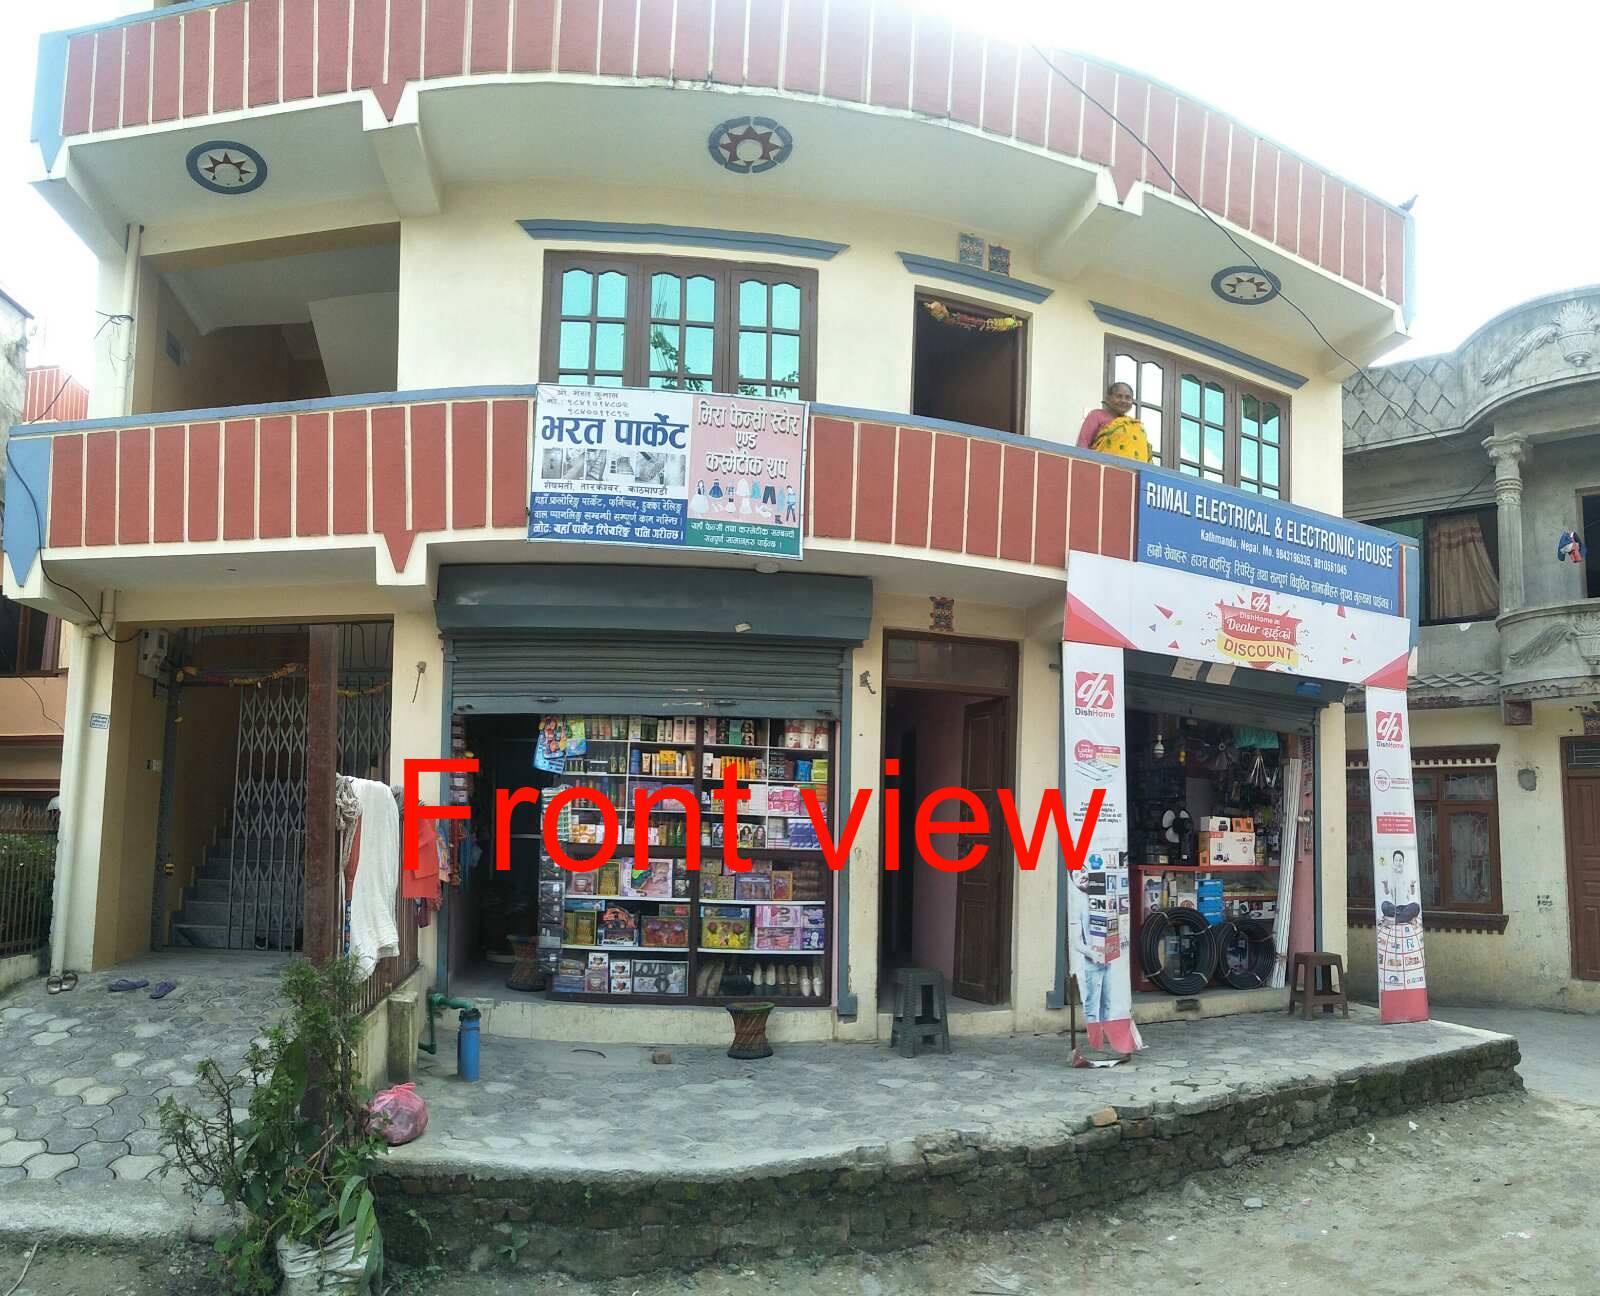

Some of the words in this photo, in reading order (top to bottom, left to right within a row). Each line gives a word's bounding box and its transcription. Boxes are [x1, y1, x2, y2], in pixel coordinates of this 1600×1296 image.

[542, 415, 606, 445] भरत
[771, 409, 800, 436] स्टोर
[1146, 481, 1192, 516] RIMAL
[1195, 494, 1271, 537] ELECTRICAL
[1274, 516, 1283, 539] &
[1286, 520, 1355, 558] ELECTRONIC
[1357, 540, 1393, 568] HOUSE
[1200, 528, 1238, 550] Kathmandu,
[1225, 615, 1260, 634] Dealer
[1223, 638, 1294, 660] DISCOUNT
[1075, 708, 1116, 719] DishHome
[1376, 741, 1404, 749] DishHome
